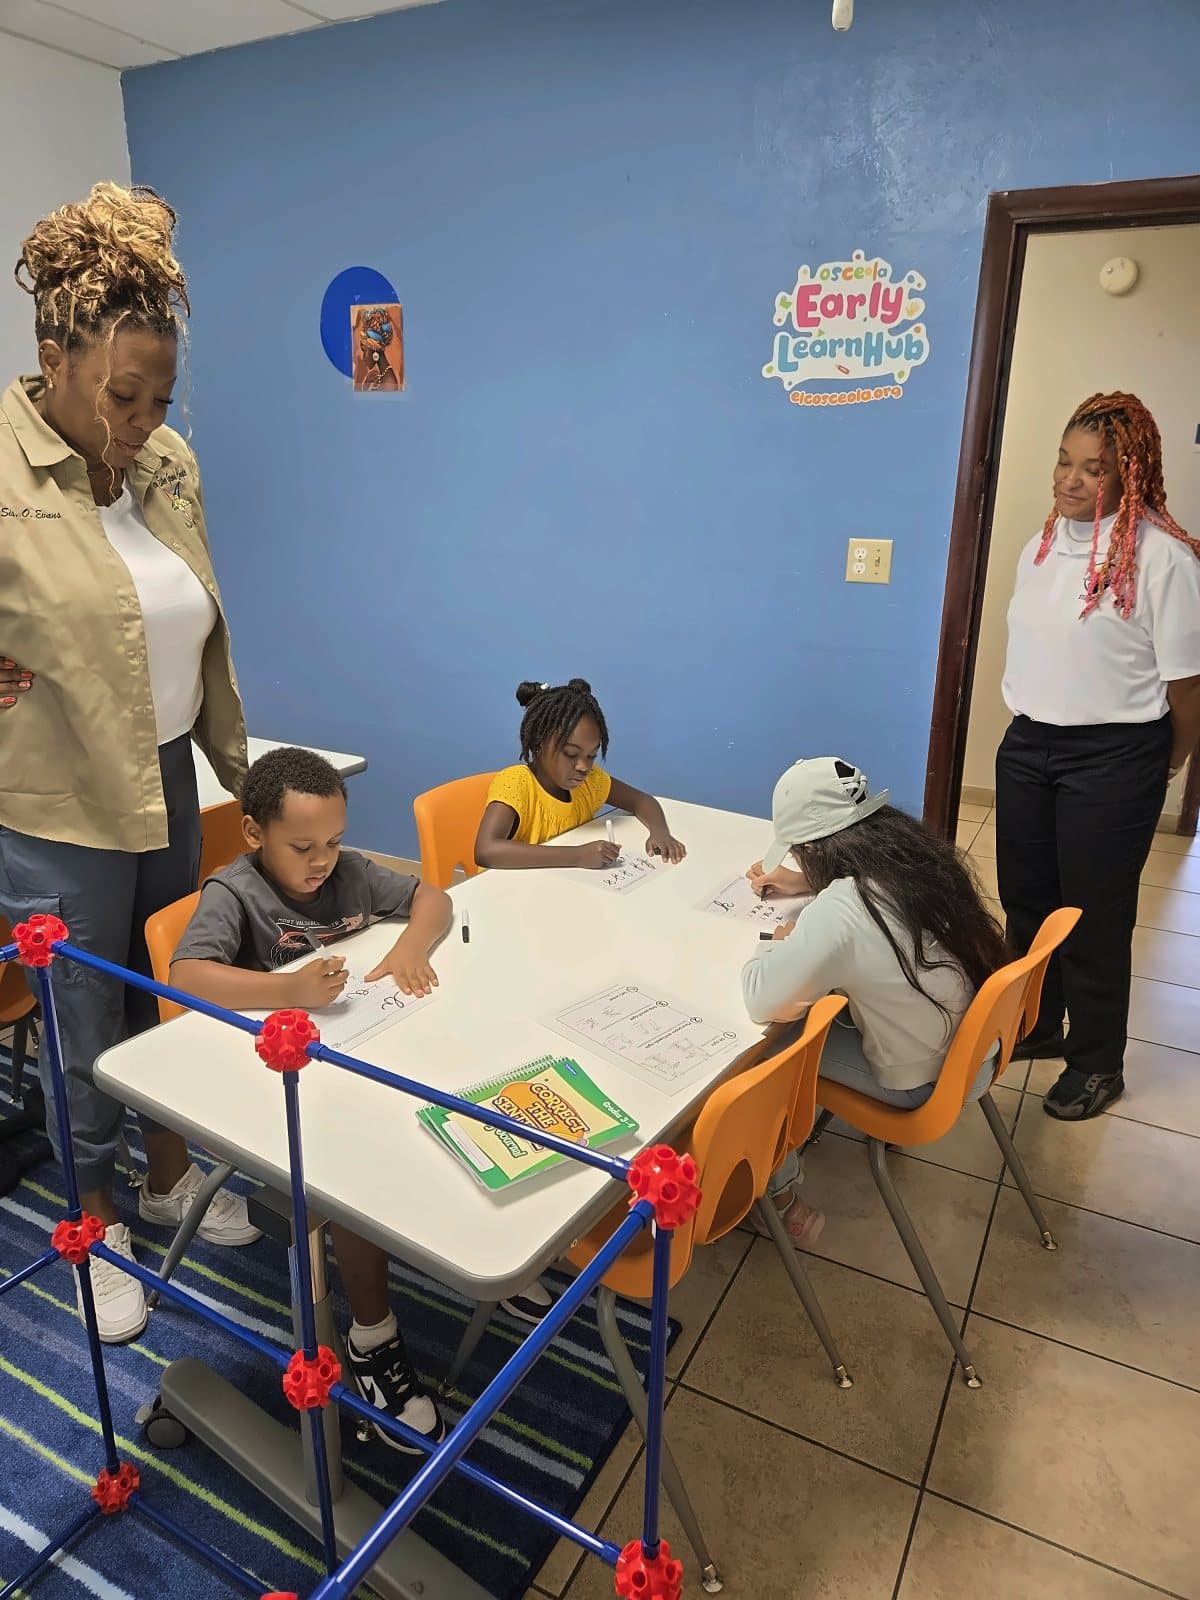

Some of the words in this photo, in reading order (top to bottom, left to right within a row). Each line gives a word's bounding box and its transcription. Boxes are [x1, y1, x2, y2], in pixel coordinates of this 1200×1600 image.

[820, 262, 887, 282] osceola
[796, 282, 903, 328] Early
[778, 331, 924, 373] LearnHub
[791, 386, 901, 406] elcosceola.org
[1, 507, 18, 518] Sis.
[21, 508, 33, 518] O.
[35, 509, 61, 519] Evans
[524, 1101, 559, 1129] THE
[530, 1083, 590, 1134] CORRECT
